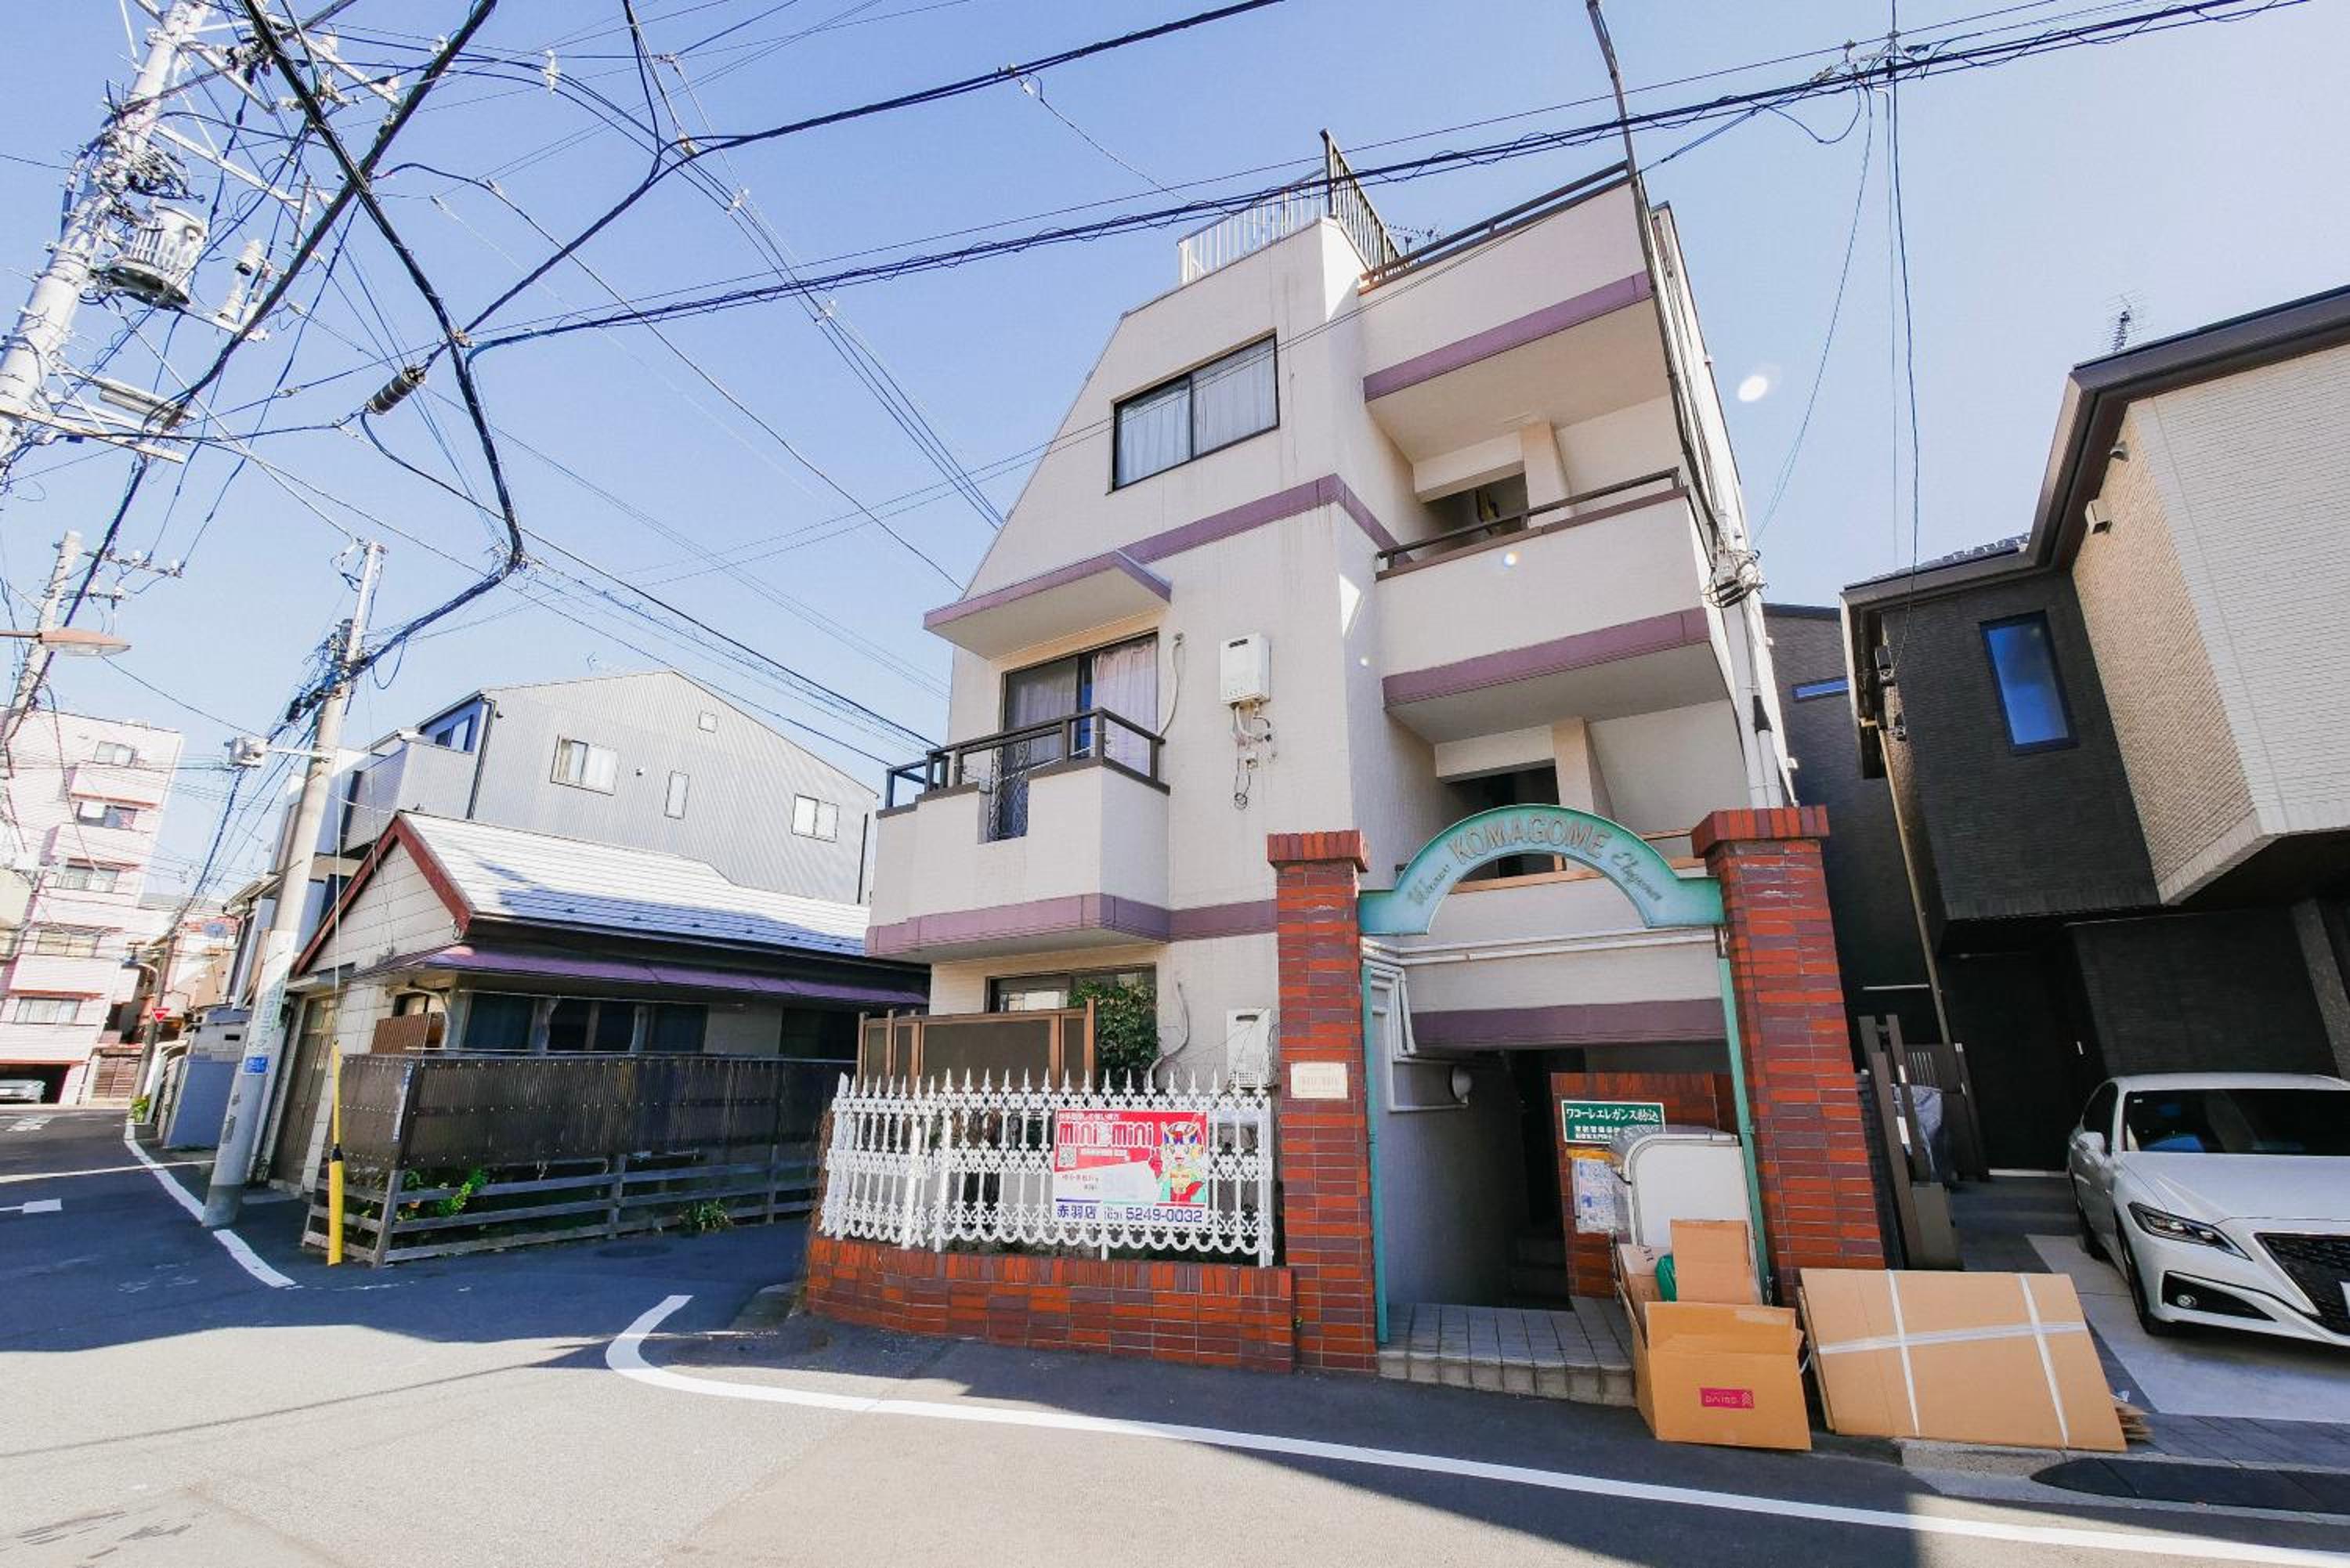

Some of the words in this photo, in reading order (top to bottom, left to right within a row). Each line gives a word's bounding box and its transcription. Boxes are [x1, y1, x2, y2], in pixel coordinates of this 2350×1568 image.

[1449, 817, 1610, 864] KOMAGOME
[1058, 1205, 1097, 1219] 赤羽店
[1126, 1207, 1203, 1223] 5249-0032
